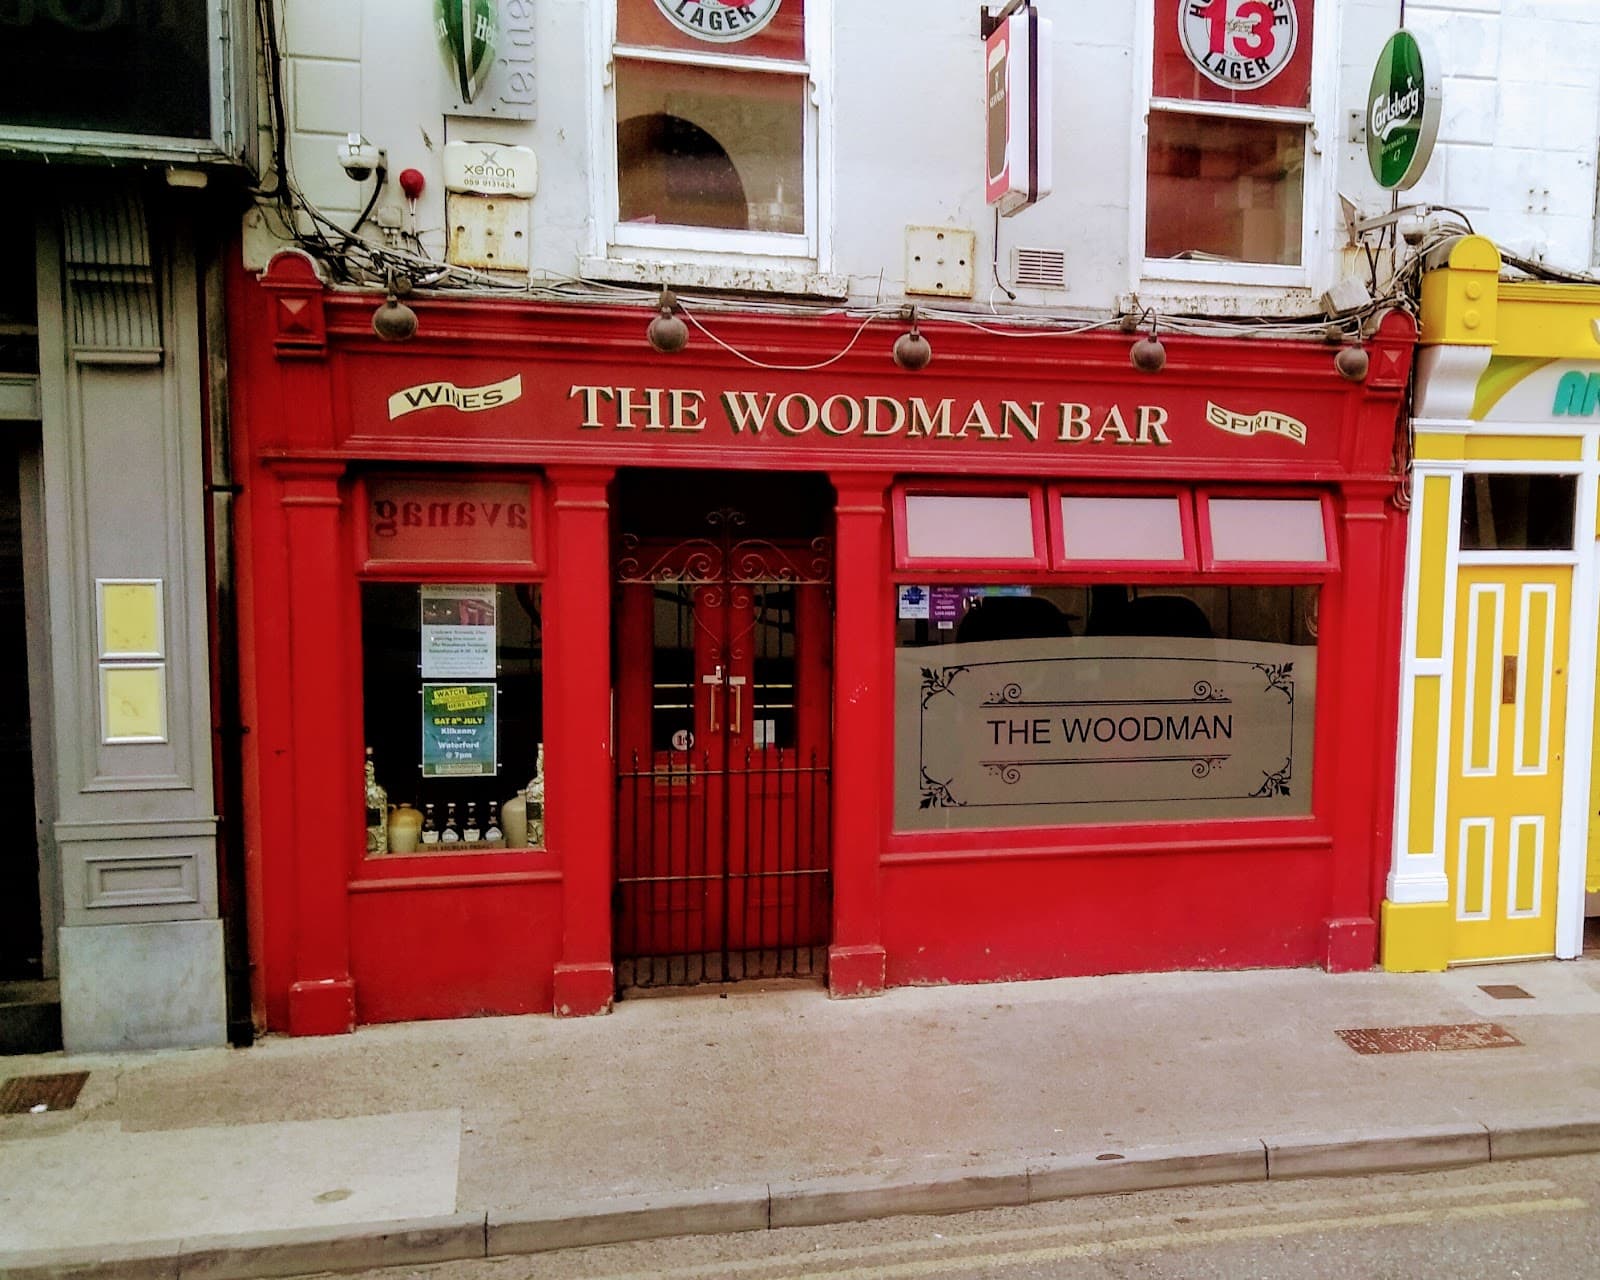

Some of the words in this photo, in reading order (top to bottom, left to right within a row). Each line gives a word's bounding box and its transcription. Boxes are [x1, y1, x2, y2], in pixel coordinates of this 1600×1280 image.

[675, 0, 757, 31] LAGER
[1204, 0, 1275, 59] 13
[1202, 50, 1270, 79] LAGER
[1372, 82, 1419, 137] Carlsberg
[463, 165, 515, 178] xenon
[404, 385, 504, 409] WINES
[569, 385, 707, 431] THE
[721, 391, 1045, 441] WOODMAN
[1056, 402, 1172, 444] BAR
[1210, 407, 1303, 438] SPIRITS
[436, 688, 466, 698] WATCH
[441, 728, 477, 736] Kilkenny
[987, 720, 1051, 745] THE
[1062, 715, 1232, 743] WOODMAN
[438, 741, 480, 749] Waterford
[454, 752, 473, 760] 7pm
